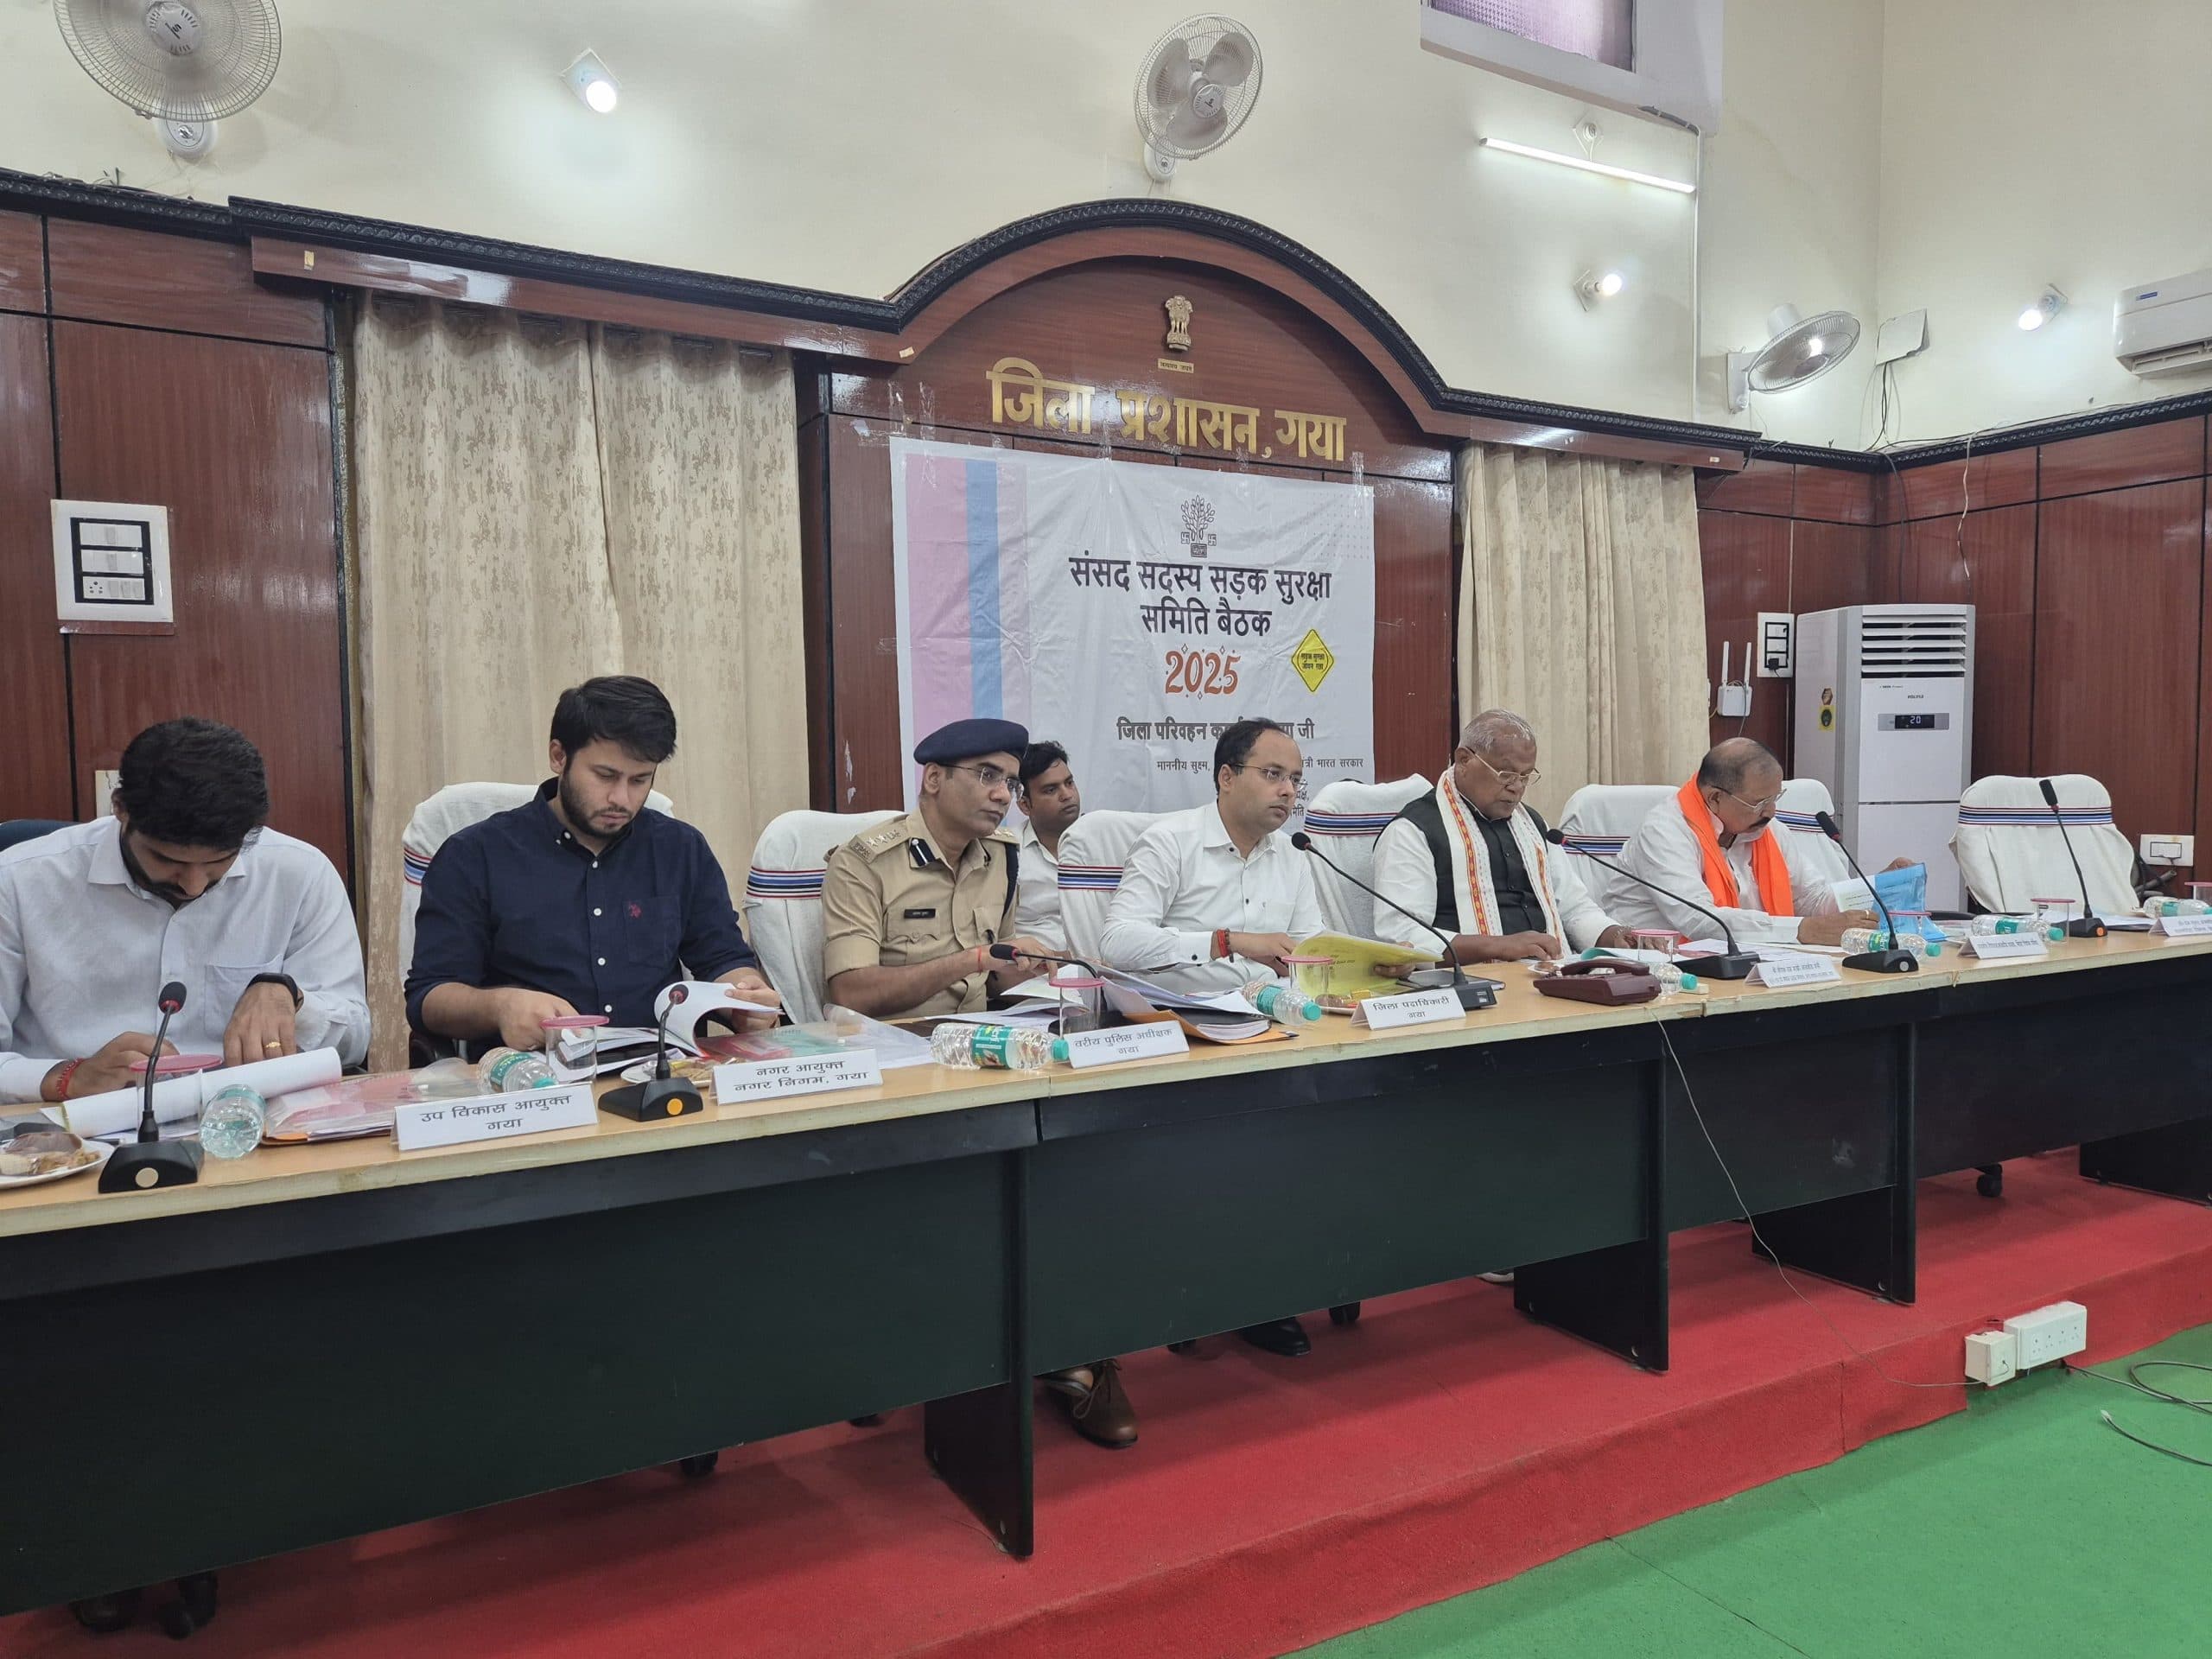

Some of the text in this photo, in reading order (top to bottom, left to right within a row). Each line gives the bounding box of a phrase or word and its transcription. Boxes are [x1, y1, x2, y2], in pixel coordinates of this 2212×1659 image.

[986, 357, 1096, 434] जिला
[1274, 409, 1347, 461] गया
[1069, 550, 1332, 605] संसद सदस्य सड़क सुरक्षा
[1140, 595, 1272, 637] समिति बैठक
[1165, 651, 1241, 696] 2025
[1116, 716, 1152, 741] जिला
[1154, 716, 1207, 742] परिवहन
[1297, 717, 1315, 739] जी
[1910, 715, 1922, 724] 20
[1157, 759, 1187, 771] माननीय
[1316, 759, 1335, 767] भारत
[1338, 759, 1363, 767] सरकार
[1373, 996, 1450, 1011] जिला पदाधिकारी
[1074, 1027, 1173, 1048] वरीय पुलिस अधीक्षक
[1118, 1046, 1140, 1054] गया
[755, 1060, 846, 1077] नगर आयुक्त
[734, 1081, 772, 1092] नगर
[836, 1071, 870, 1082] गया
[420, 1094, 573, 1122] उप विकास आयुक्त
[486, 1118, 524, 1131] गया
